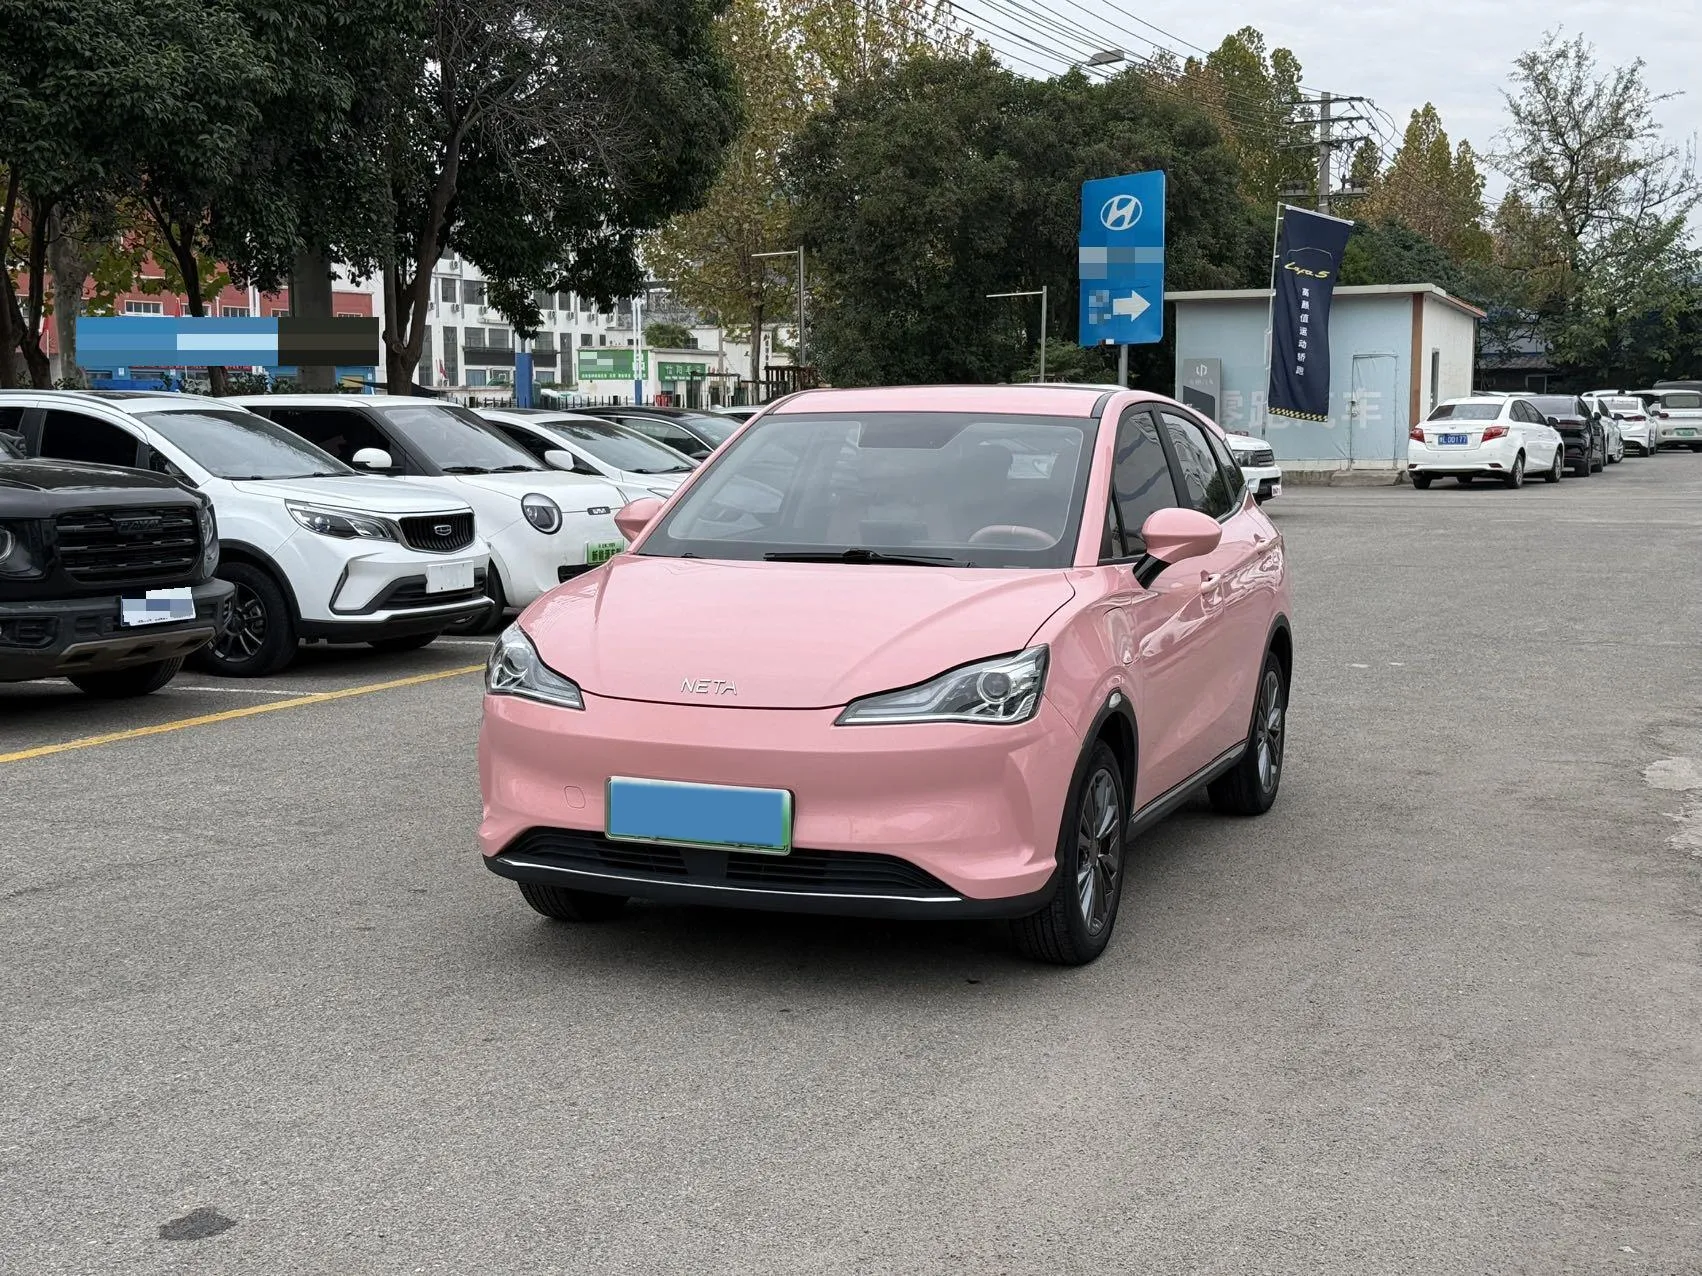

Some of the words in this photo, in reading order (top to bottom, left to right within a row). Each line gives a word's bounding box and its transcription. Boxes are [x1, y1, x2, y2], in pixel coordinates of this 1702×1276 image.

[1222, 387, 1384, 429] 零跑车
[680, 677, 738, 696] NETA
